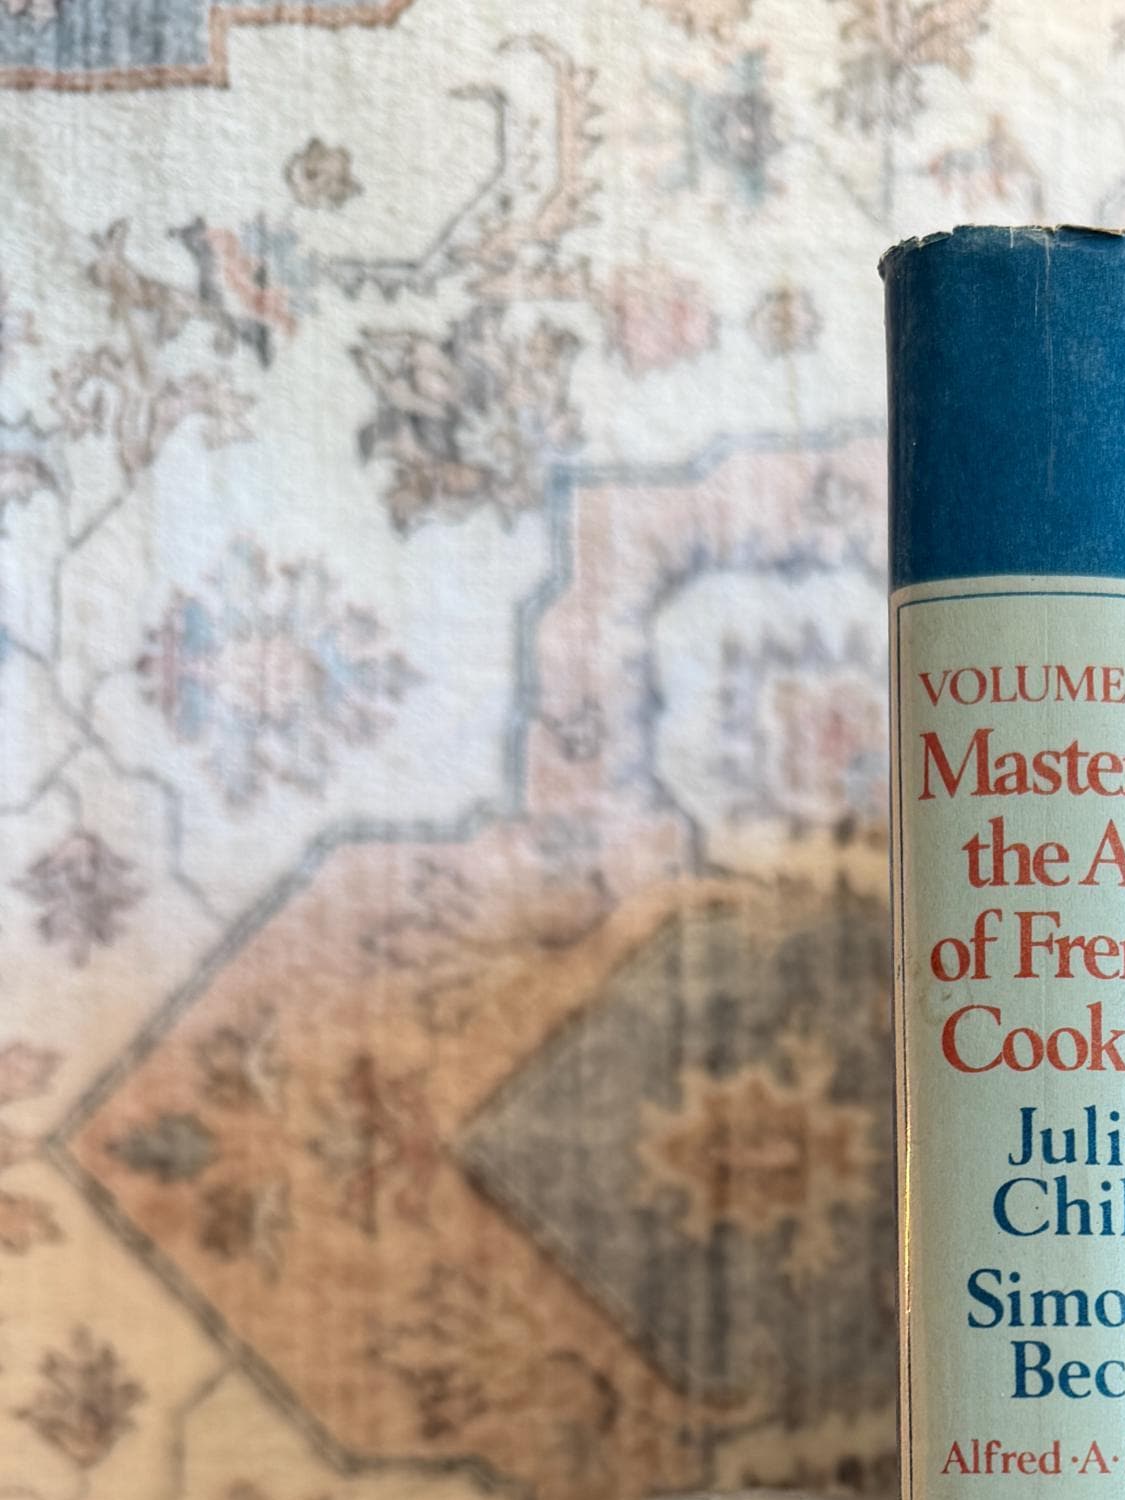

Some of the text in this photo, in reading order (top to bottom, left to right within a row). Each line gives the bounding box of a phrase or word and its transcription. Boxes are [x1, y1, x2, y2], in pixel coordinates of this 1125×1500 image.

[962, 816, 1069, 888] the
[930, 909, 1003, 982] of
[941, 1439, 1062, 1475] Alfred
